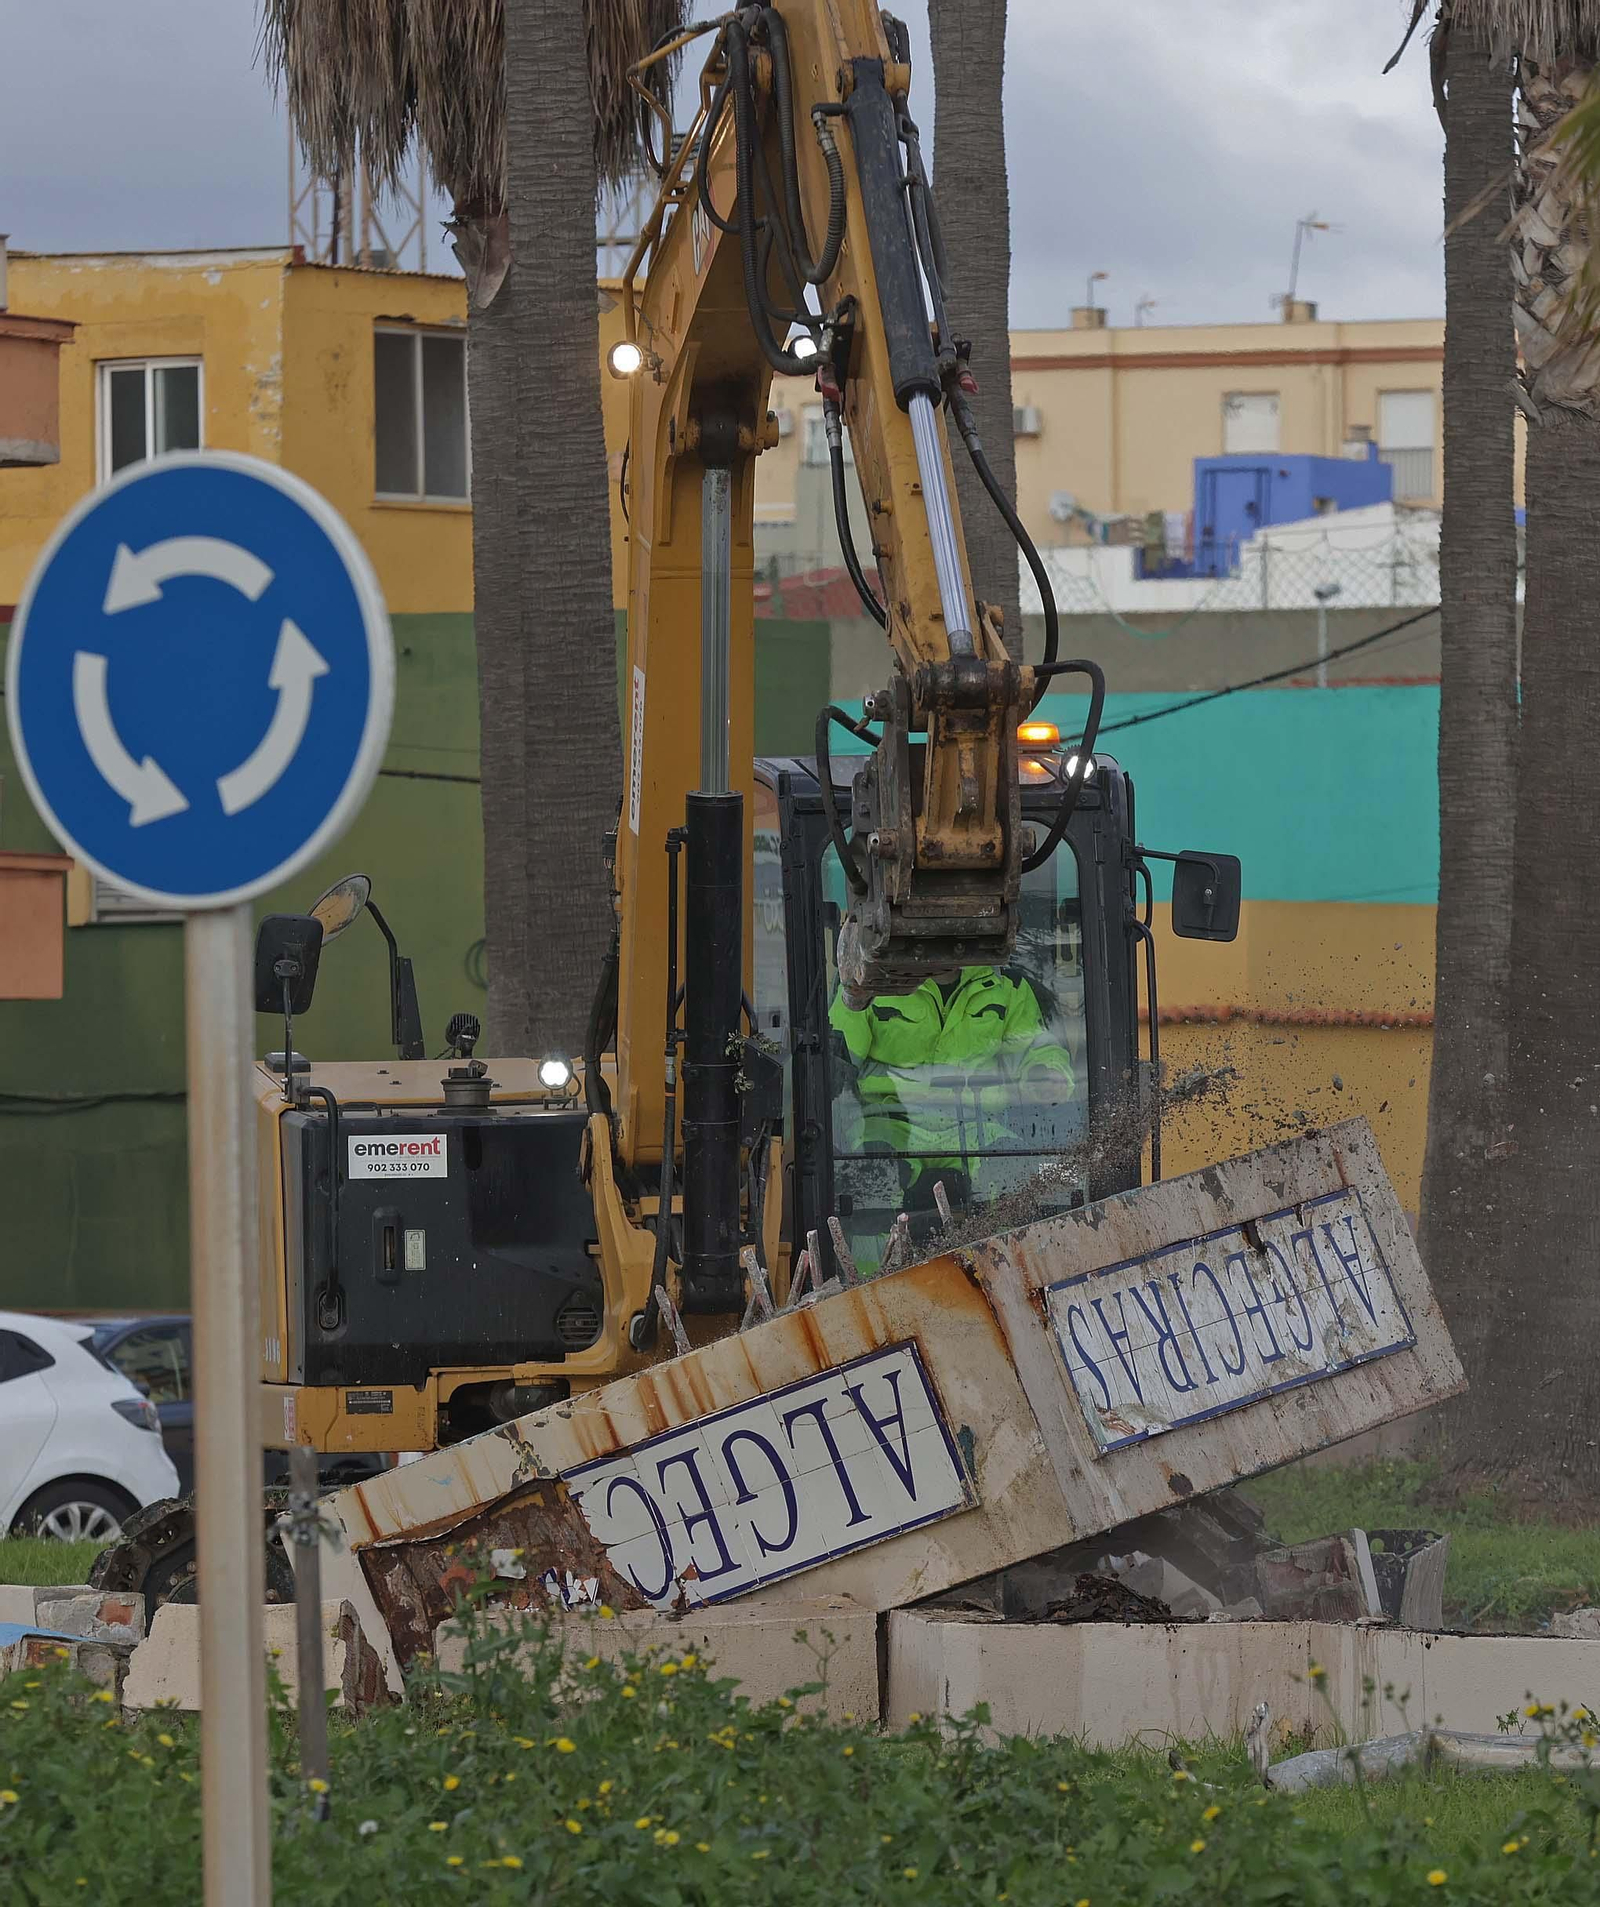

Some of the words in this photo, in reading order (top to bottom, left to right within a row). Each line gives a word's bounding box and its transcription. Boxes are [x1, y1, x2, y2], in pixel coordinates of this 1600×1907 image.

[354, 1136, 441, 1156] emerent
[367, 1163, 387, 1172] 902
[389, 1163, 408, 1172] 333
[410, 1163, 430, 1171] 070
[1067, 1216, 1379, 1411] ALGECIRAS
